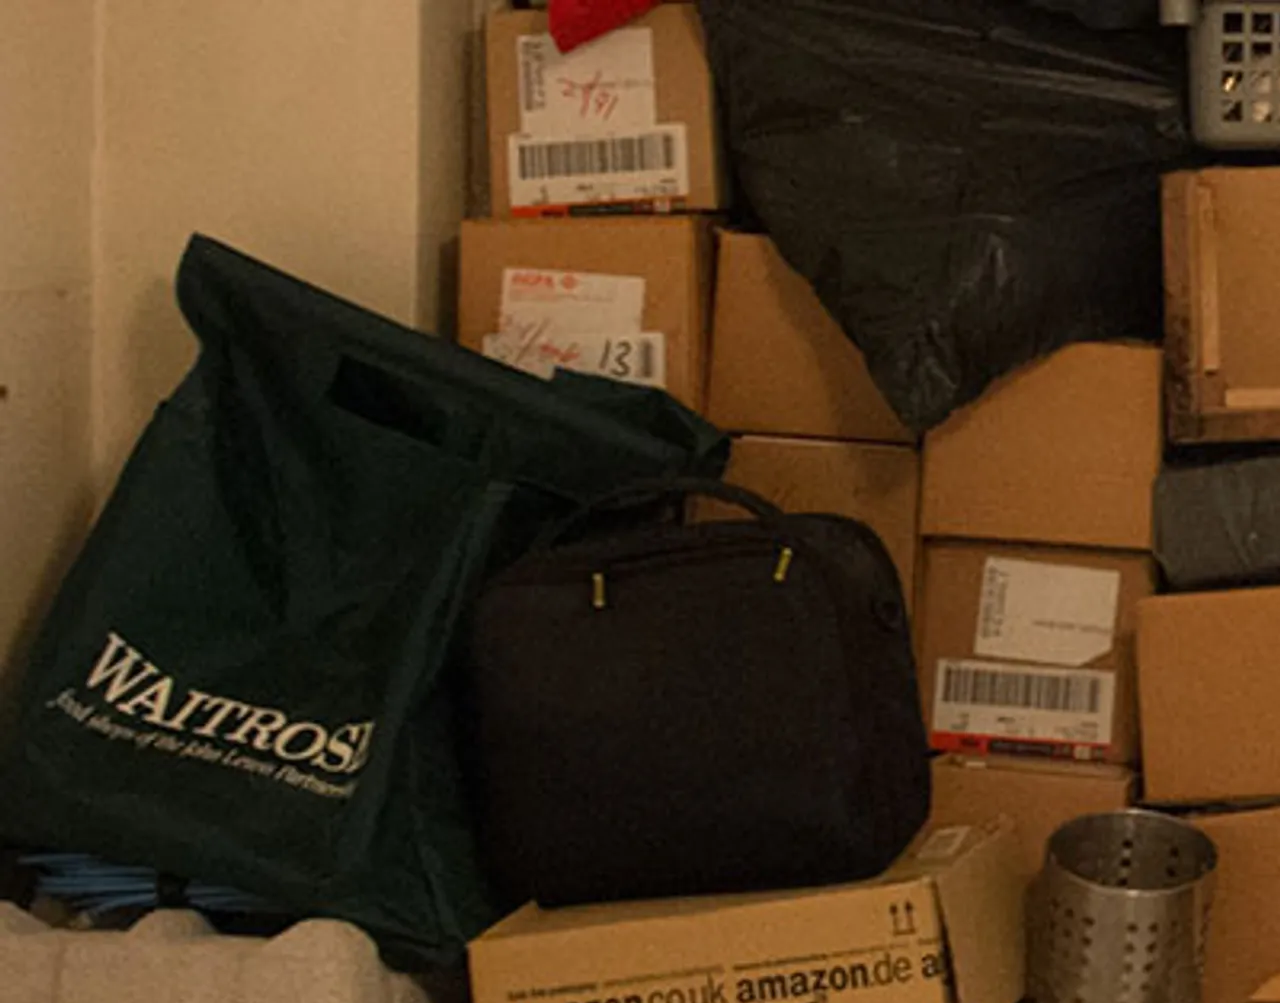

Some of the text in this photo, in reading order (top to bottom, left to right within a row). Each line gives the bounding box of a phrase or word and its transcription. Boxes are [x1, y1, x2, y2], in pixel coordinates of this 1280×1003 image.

[599, 339, 632, 377] 13
[86, 631, 375, 774] WAITROS
[735, 950, 913, 1003] amazon.de
